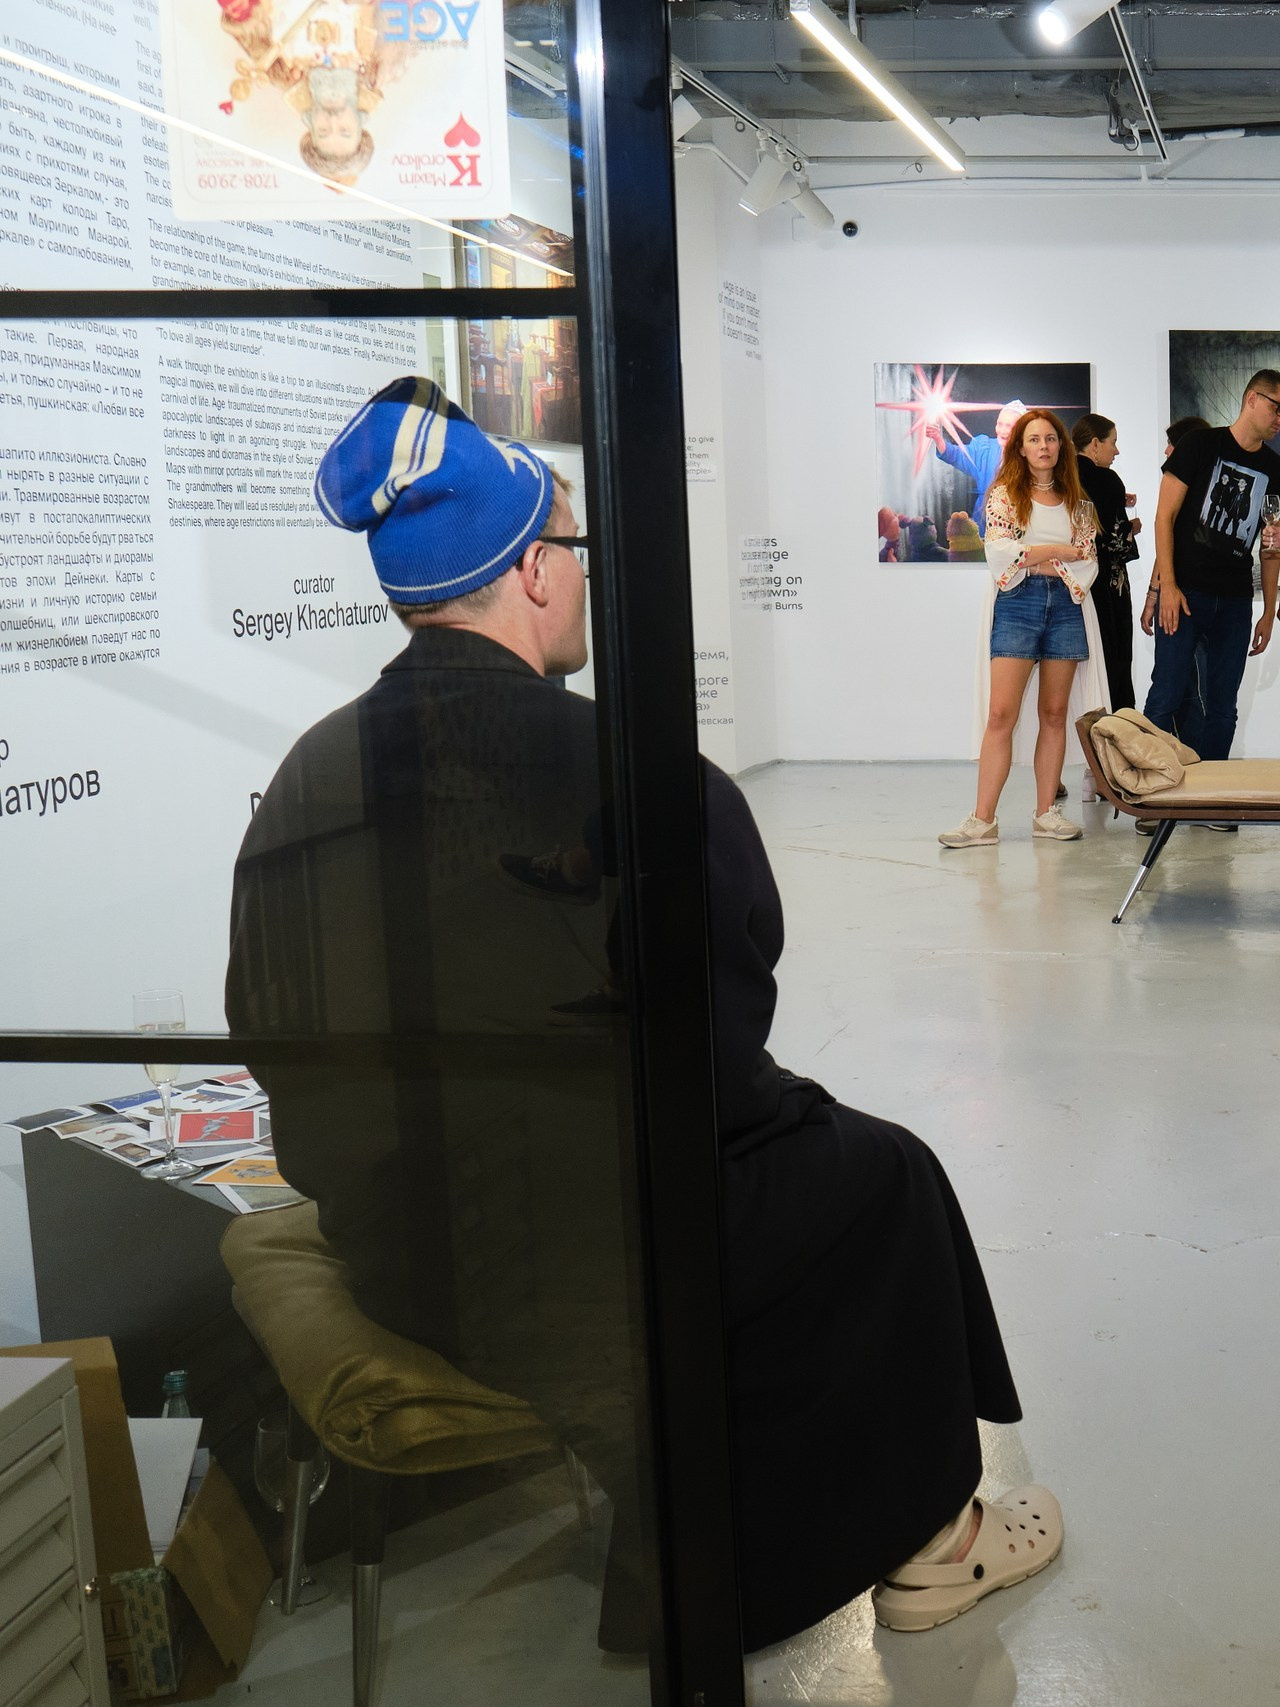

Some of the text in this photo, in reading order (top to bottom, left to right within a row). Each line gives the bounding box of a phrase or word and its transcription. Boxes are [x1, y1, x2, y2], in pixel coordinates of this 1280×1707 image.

[446, 154, 483, 187] K
[293, 575, 335, 595] curator
[232, 601, 388, 641] Sergey Khachaturov
